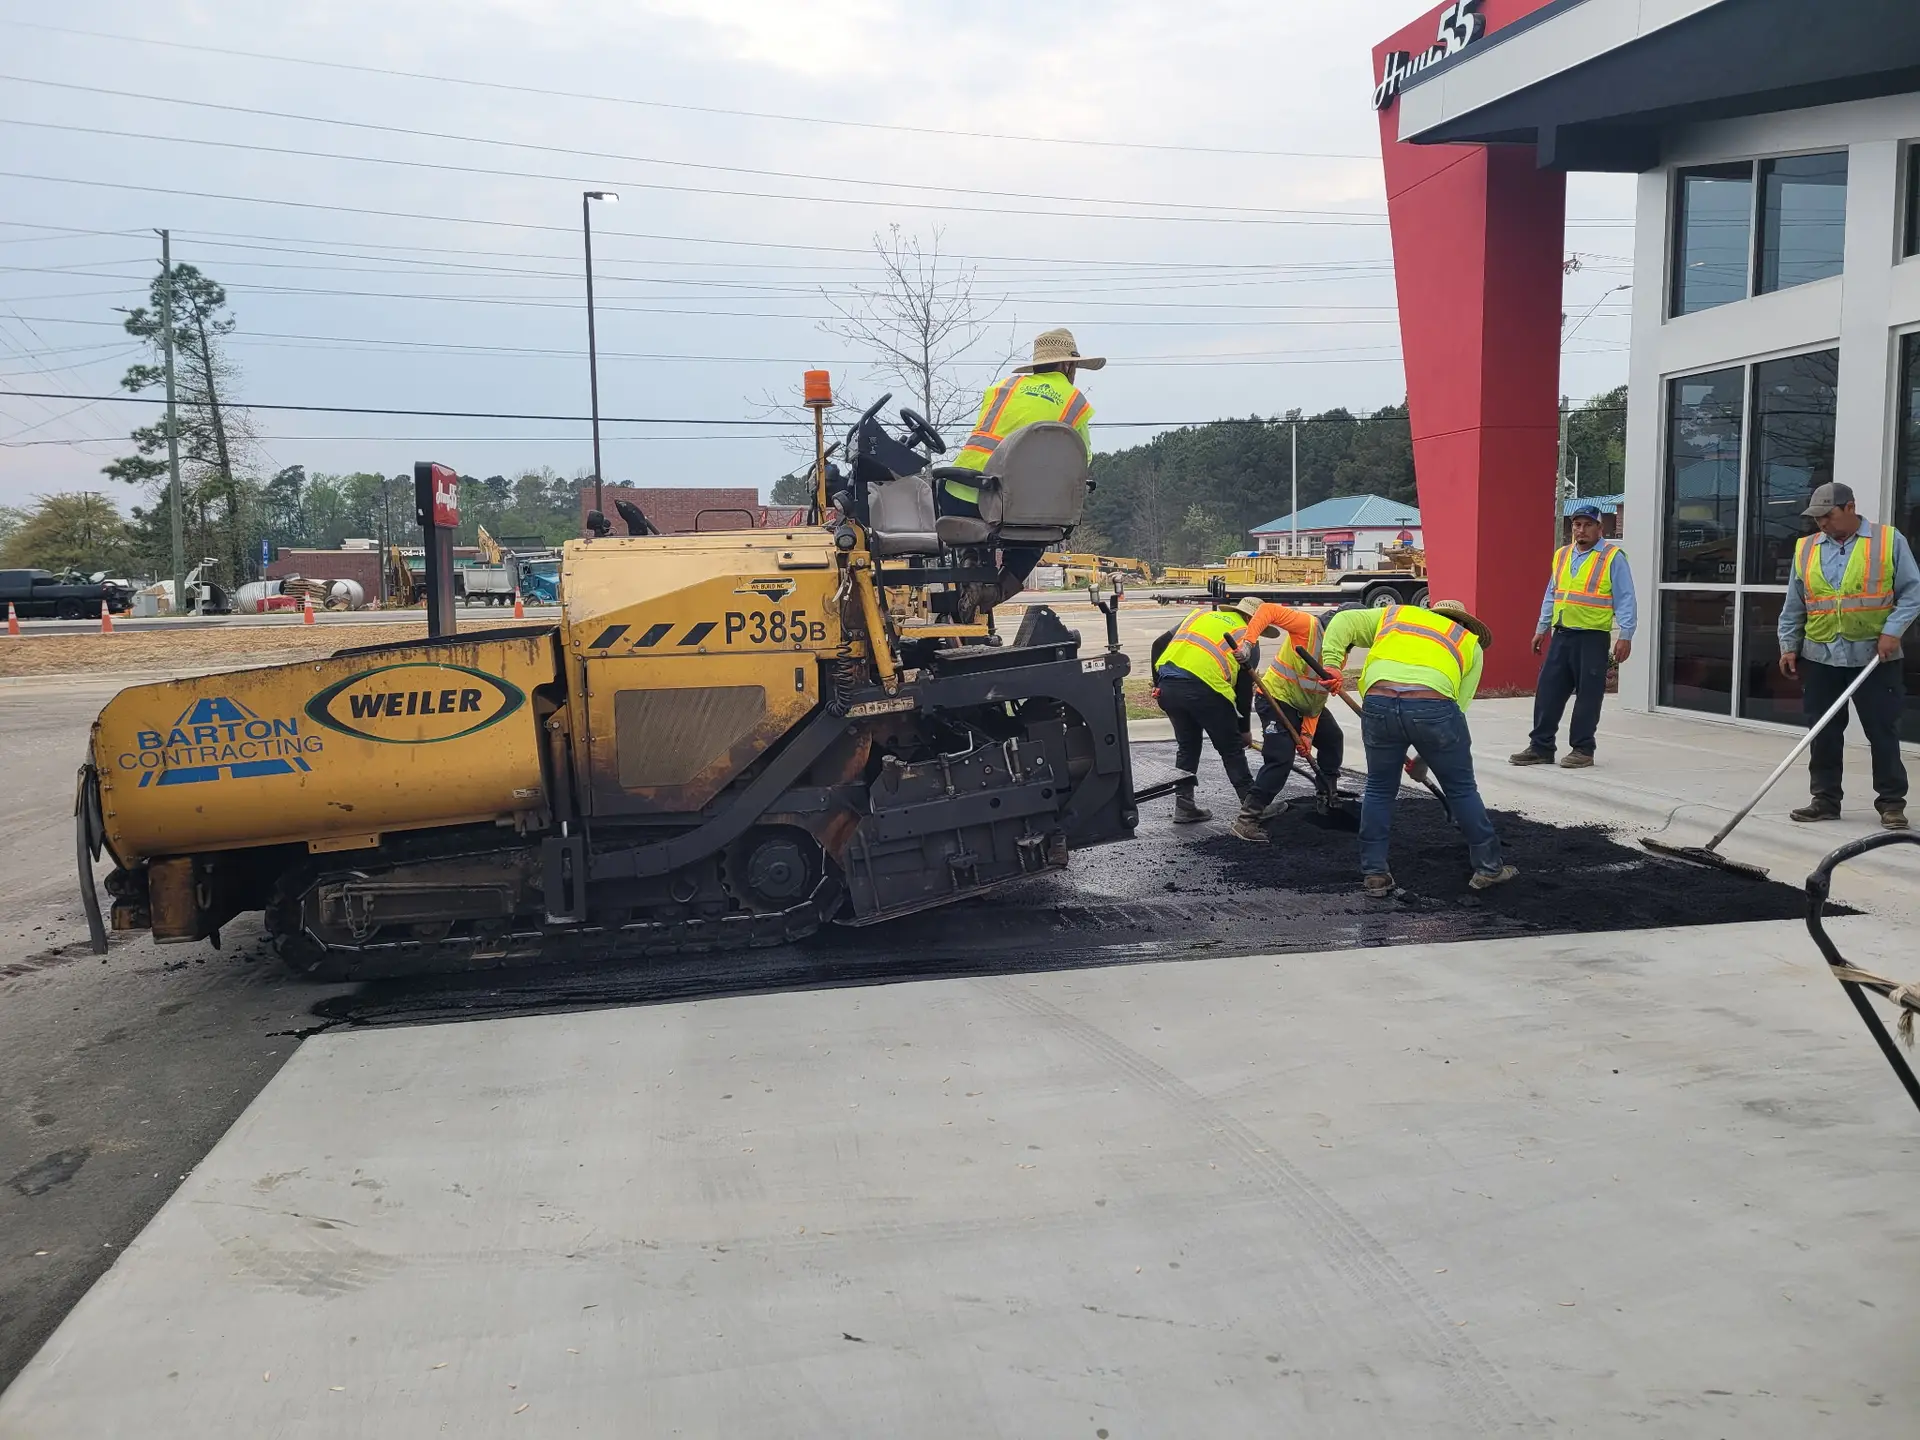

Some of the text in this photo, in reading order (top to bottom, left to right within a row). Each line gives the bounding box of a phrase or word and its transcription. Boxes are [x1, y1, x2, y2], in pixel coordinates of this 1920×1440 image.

[1437, 0, 1481, 57] 55
[350, 689, 482, 719] WEILER
[137, 717, 298, 750] BARTON
[118, 736, 323, 770] CONTRACTING
